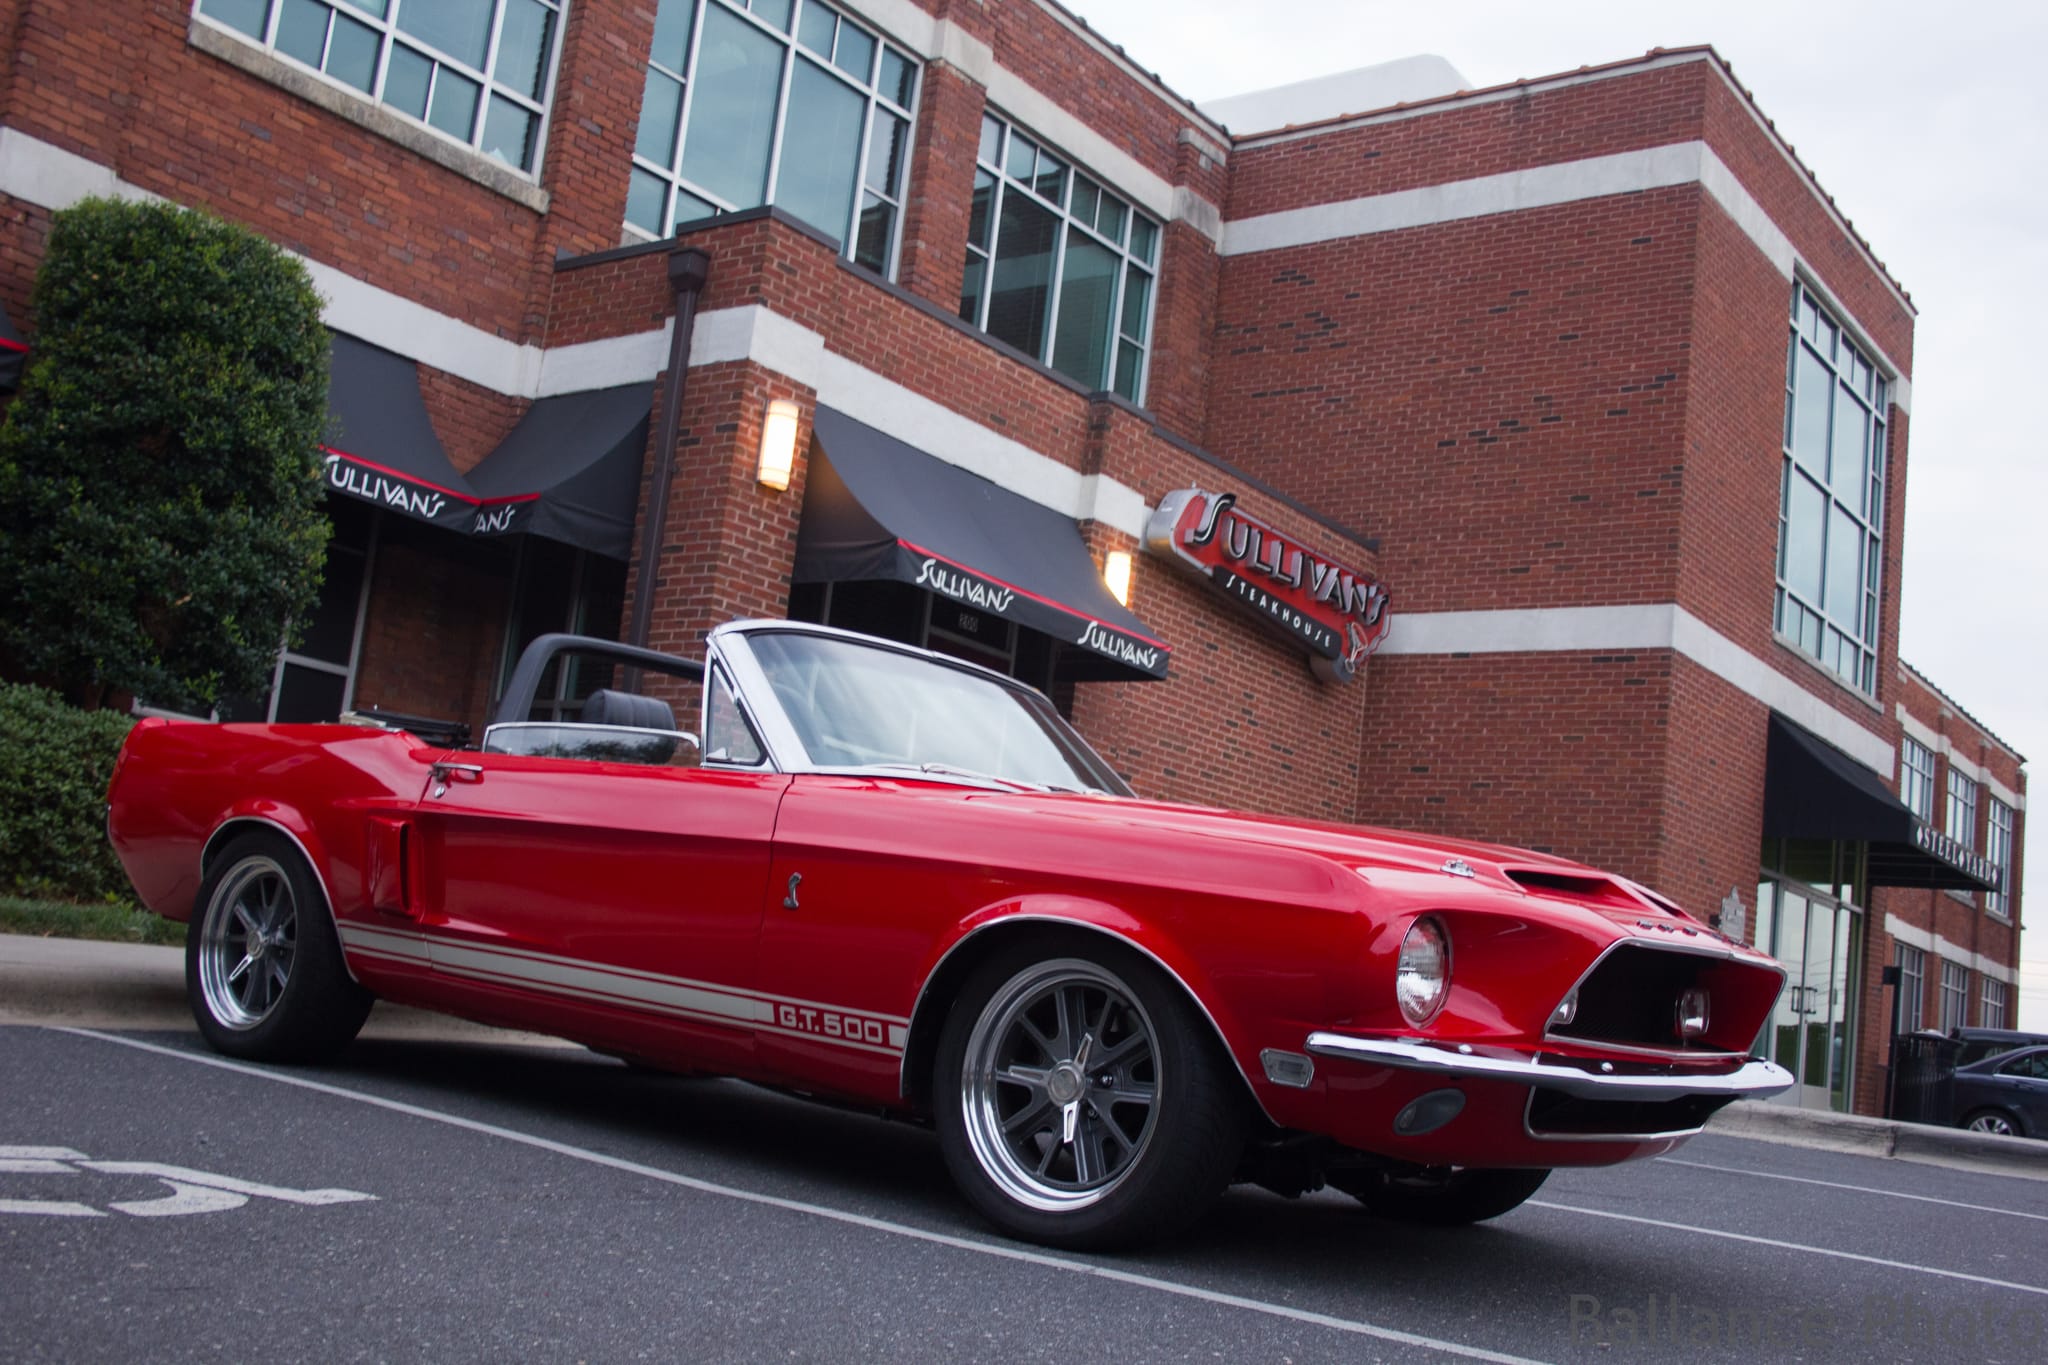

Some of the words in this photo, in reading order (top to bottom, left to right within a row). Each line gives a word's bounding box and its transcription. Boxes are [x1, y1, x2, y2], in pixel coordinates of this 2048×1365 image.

[916, 558, 1014, 612] SULLIVAN'S
[1185, 493, 1390, 625] SULLIVAN'S
[1226, 574, 1331, 648] STEAKHOUSE
[1077, 621, 1158, 668] SULLIVAN'S
[1923, 826, 1958, 865] STEEL
[1966, 852, 1991, 881] YARD
